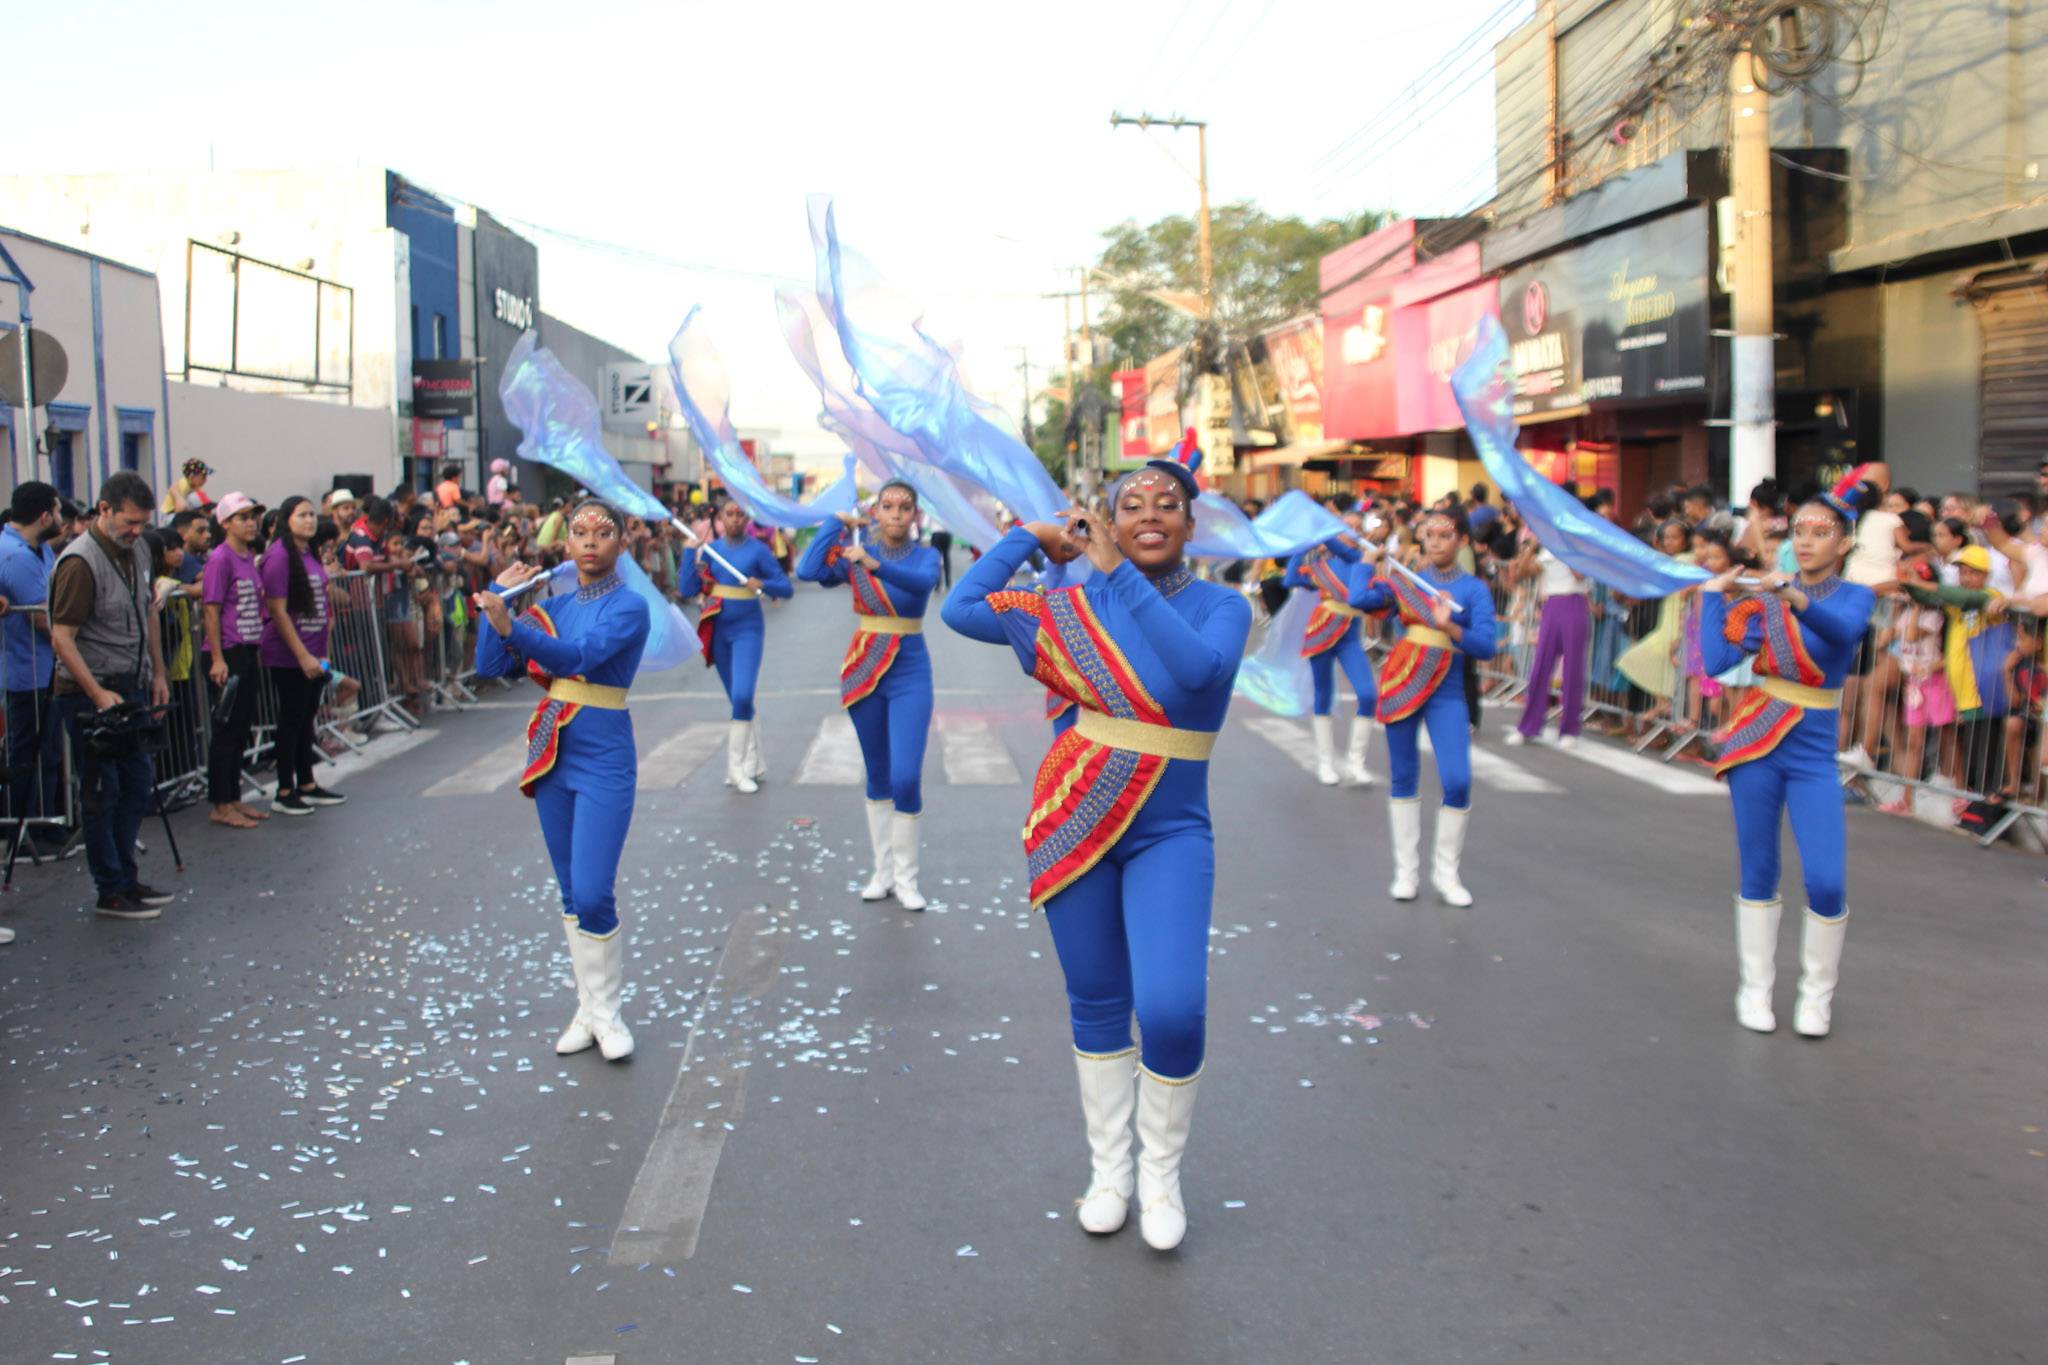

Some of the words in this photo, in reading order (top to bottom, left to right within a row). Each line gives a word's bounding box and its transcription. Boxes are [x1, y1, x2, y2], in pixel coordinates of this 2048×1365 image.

[495, 287, 525, 330] STUDIO
[1626, 291, 1676, 326] RIBEIRO
[610, 371, 620, 415] STUDIO
